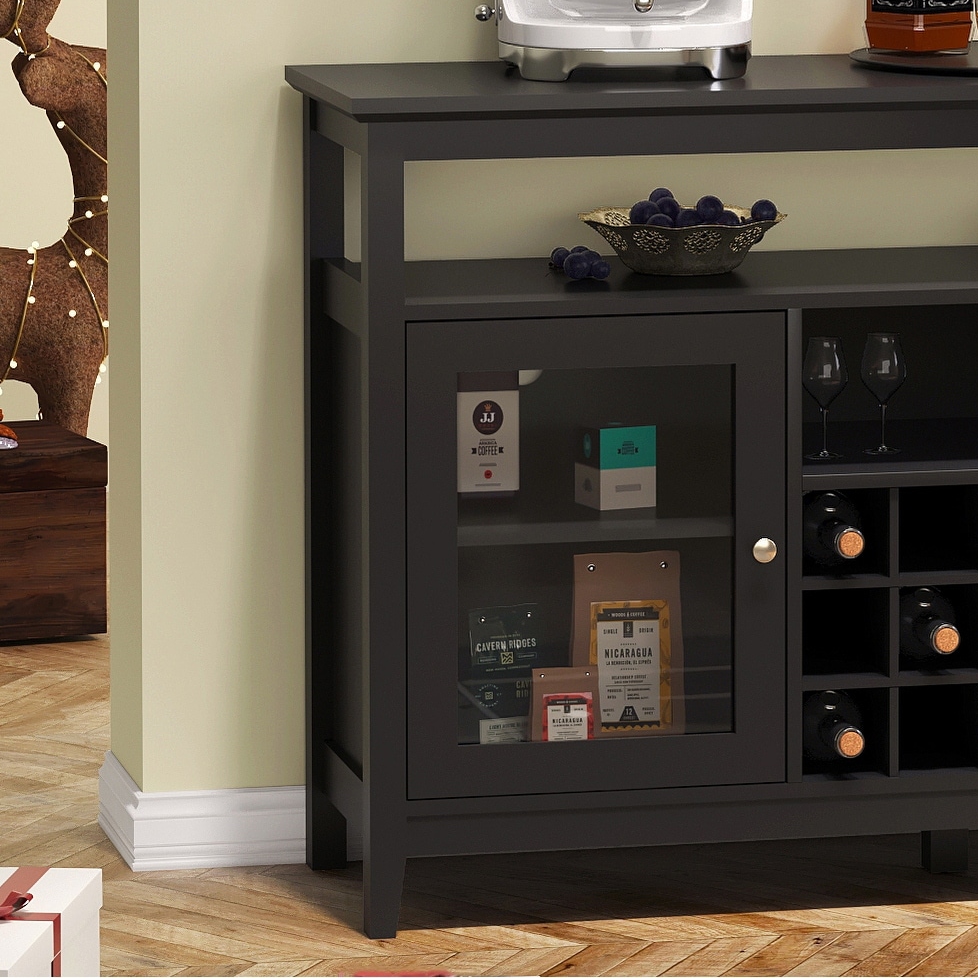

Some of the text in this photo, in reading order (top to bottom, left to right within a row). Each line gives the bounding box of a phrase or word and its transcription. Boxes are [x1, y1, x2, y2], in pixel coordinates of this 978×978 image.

[480, 412, 496, 423] JJ
[478, 446, 498, 456] COFFEE
[476, 638, 537, 652] CAVERN RIDGES
[604, 647, 653, 659] NICARAGUA
[625, 708, 633, 716] 12
